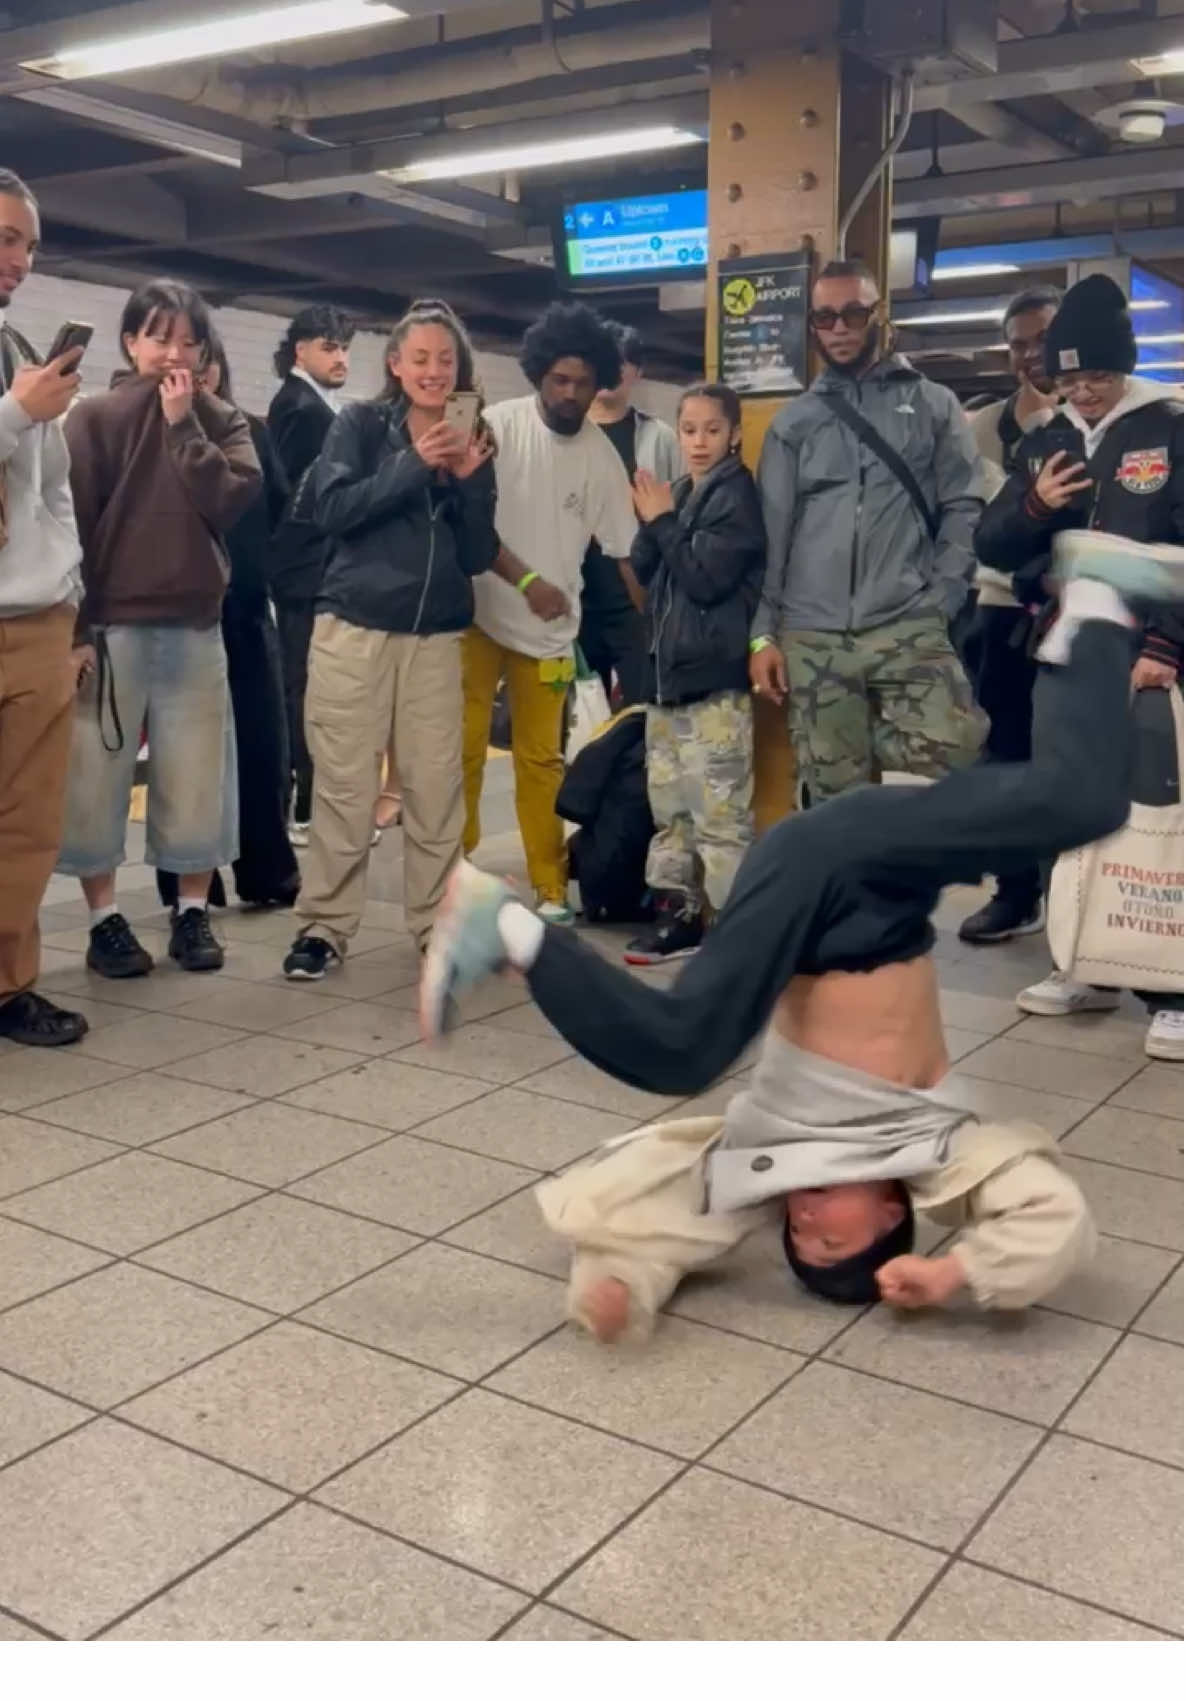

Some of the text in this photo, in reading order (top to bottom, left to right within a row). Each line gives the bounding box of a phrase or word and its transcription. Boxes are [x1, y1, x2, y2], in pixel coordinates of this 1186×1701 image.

[564, 214, 575, 229] 2
[602, 210, 615, 226] A
[756, 275, 775, 287] JFK
[756, 286, 801, 301] AIRPORT
